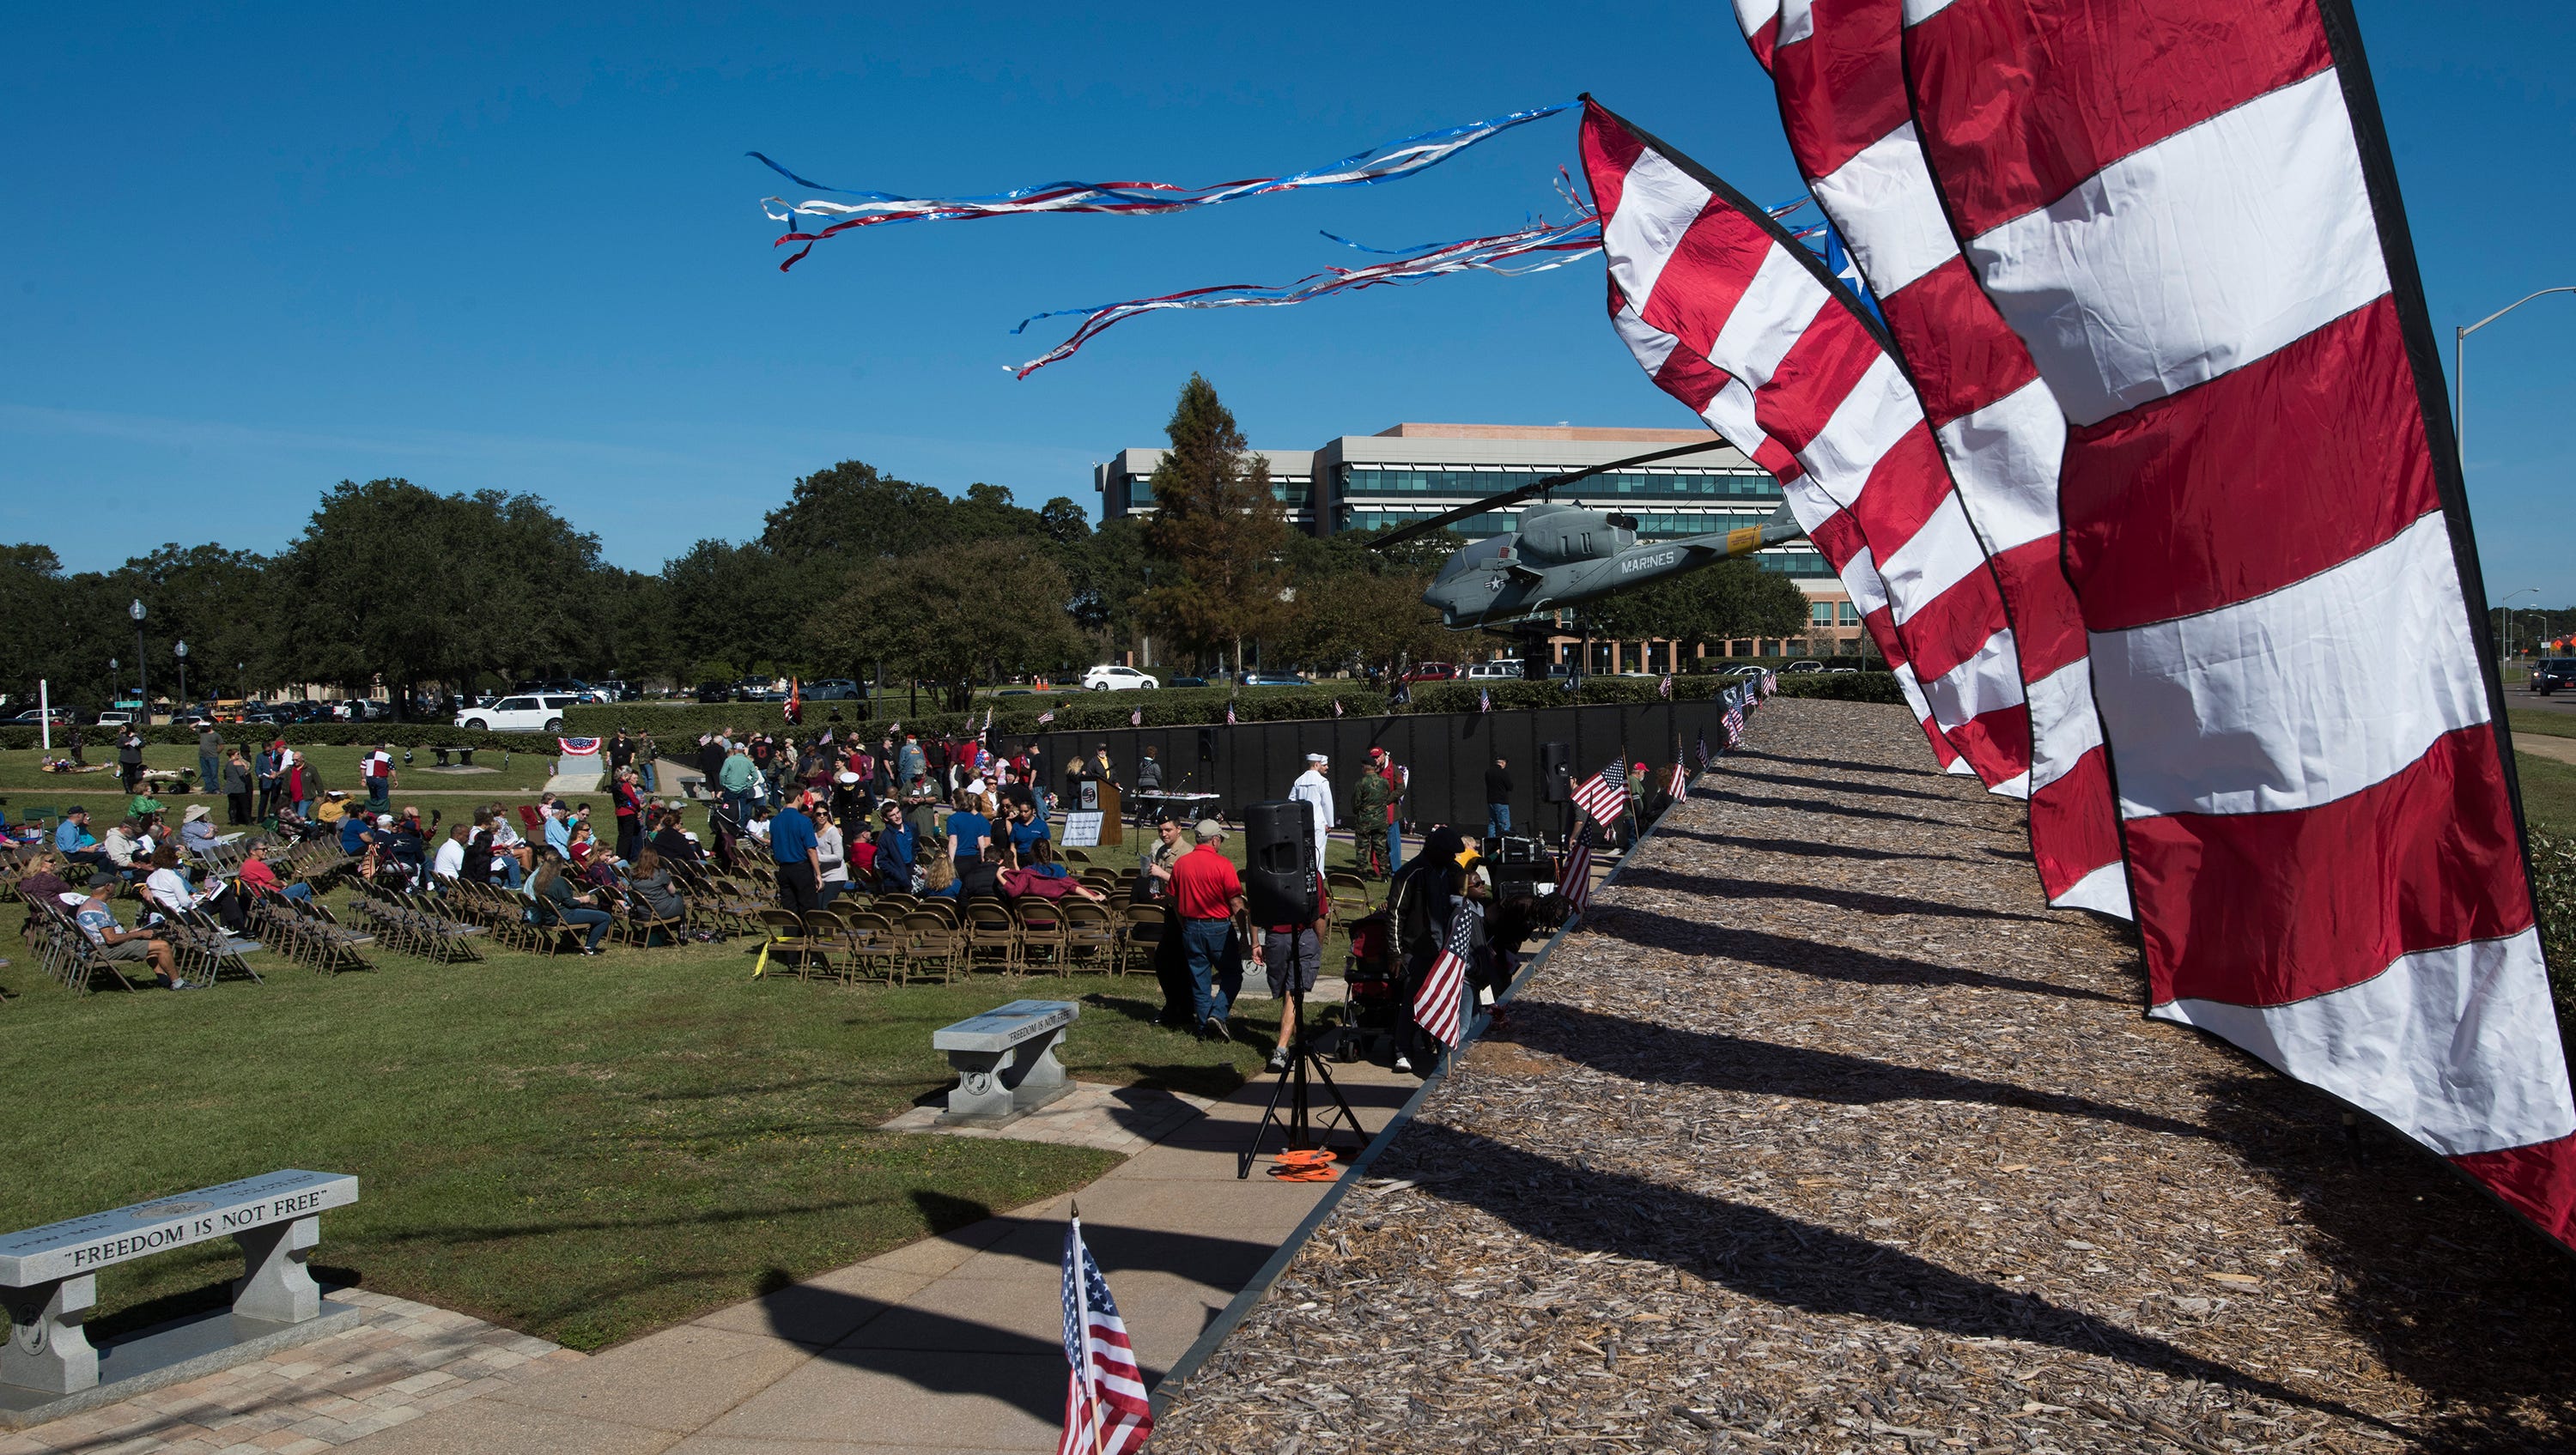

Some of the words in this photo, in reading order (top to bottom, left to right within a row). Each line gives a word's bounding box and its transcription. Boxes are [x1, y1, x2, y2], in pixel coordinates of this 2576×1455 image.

[1621, 551, 1674, 574] MARINES
[1037, 1020, 1044, 1031] IS
[1044, 1015, 1057, 1029] NOT
[194, 1217, 213, 1237] IS
[222, 1205, 266, 1230] NOT
